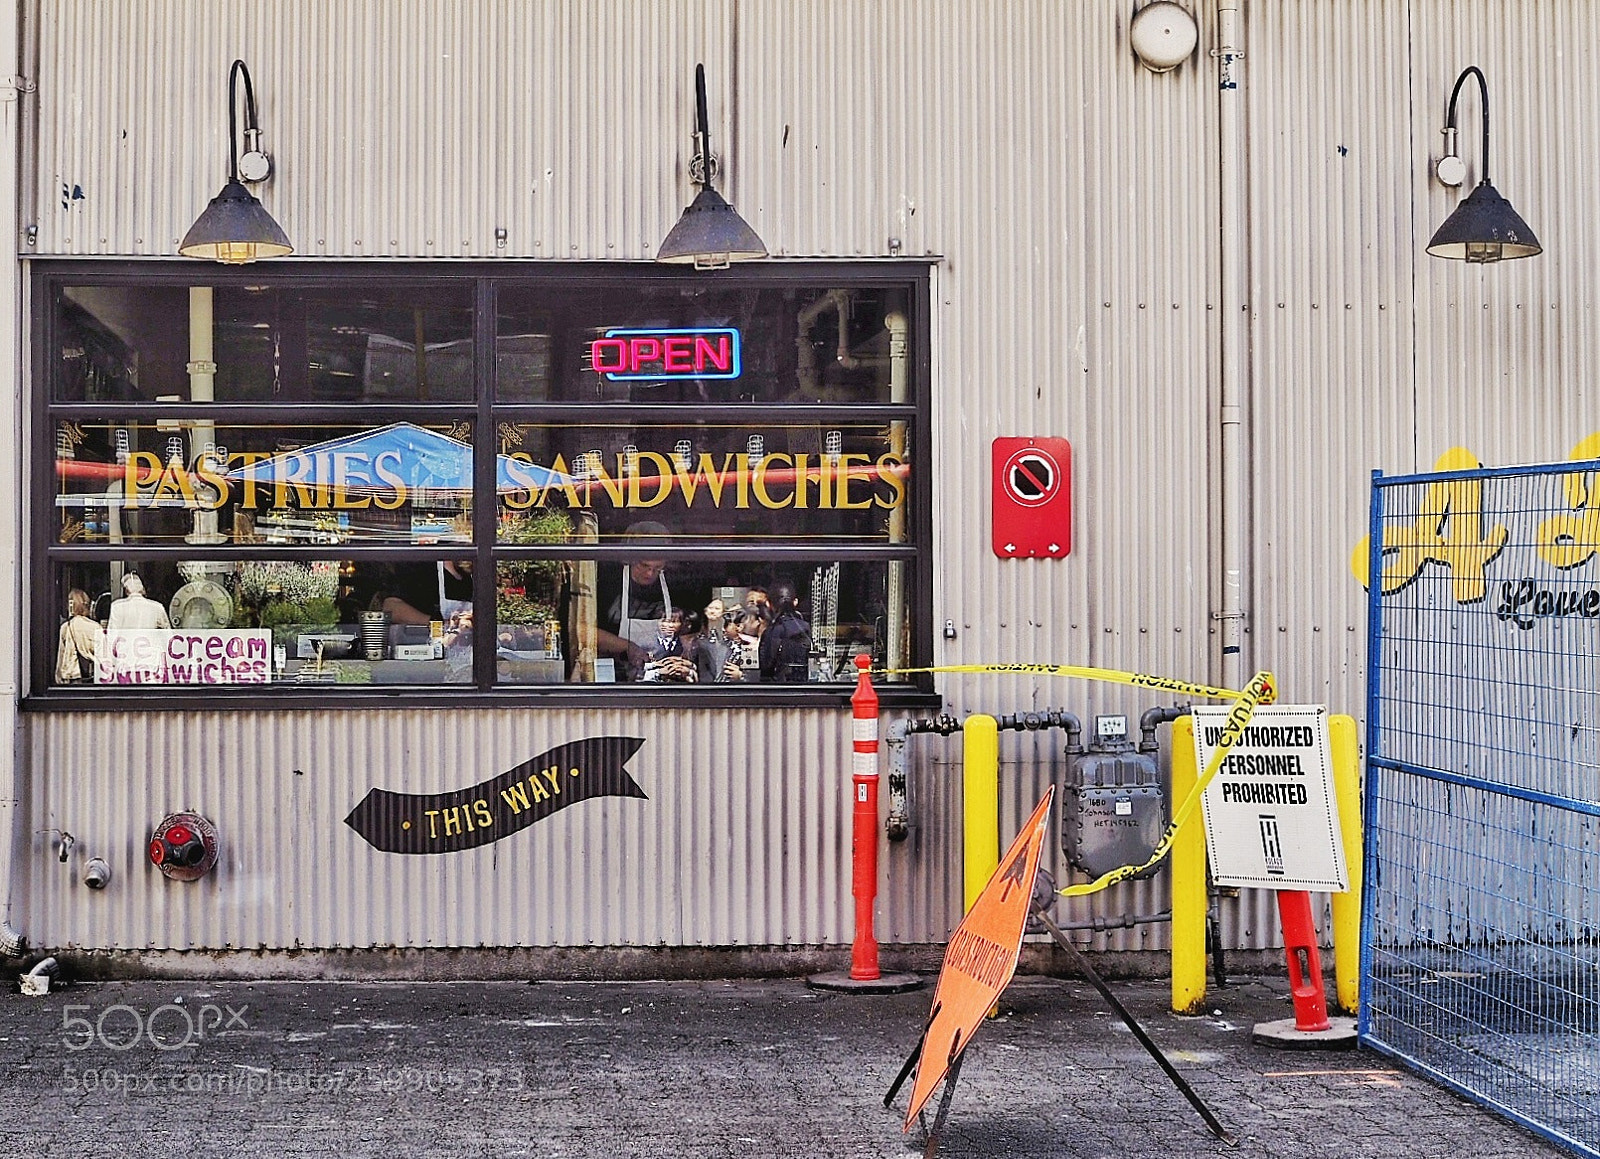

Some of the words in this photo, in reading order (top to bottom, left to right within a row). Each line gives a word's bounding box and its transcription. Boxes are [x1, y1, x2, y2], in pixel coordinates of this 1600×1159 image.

[591, 336, 731, 373] OPEN
[123, 450, 408, 511] PASTRIES
[504, 450, 906, 511] SANDWICHES
[100, 630, 153, 660] ice
[168, 634, 268, 661] cream
[99, 652, 268, 684] sandwiches
[1204, 726, 1313, 748] UNUTHORIZED
[1219, 754, 1305, 776] PERSONNEL
[424, 800, 493, 839] THIS
[500, 765, 561, 816] WAY
[1221, 782, 1308, 805] PROHIBITED
[947, 929, 1014, 991] CONSTRUCTION
